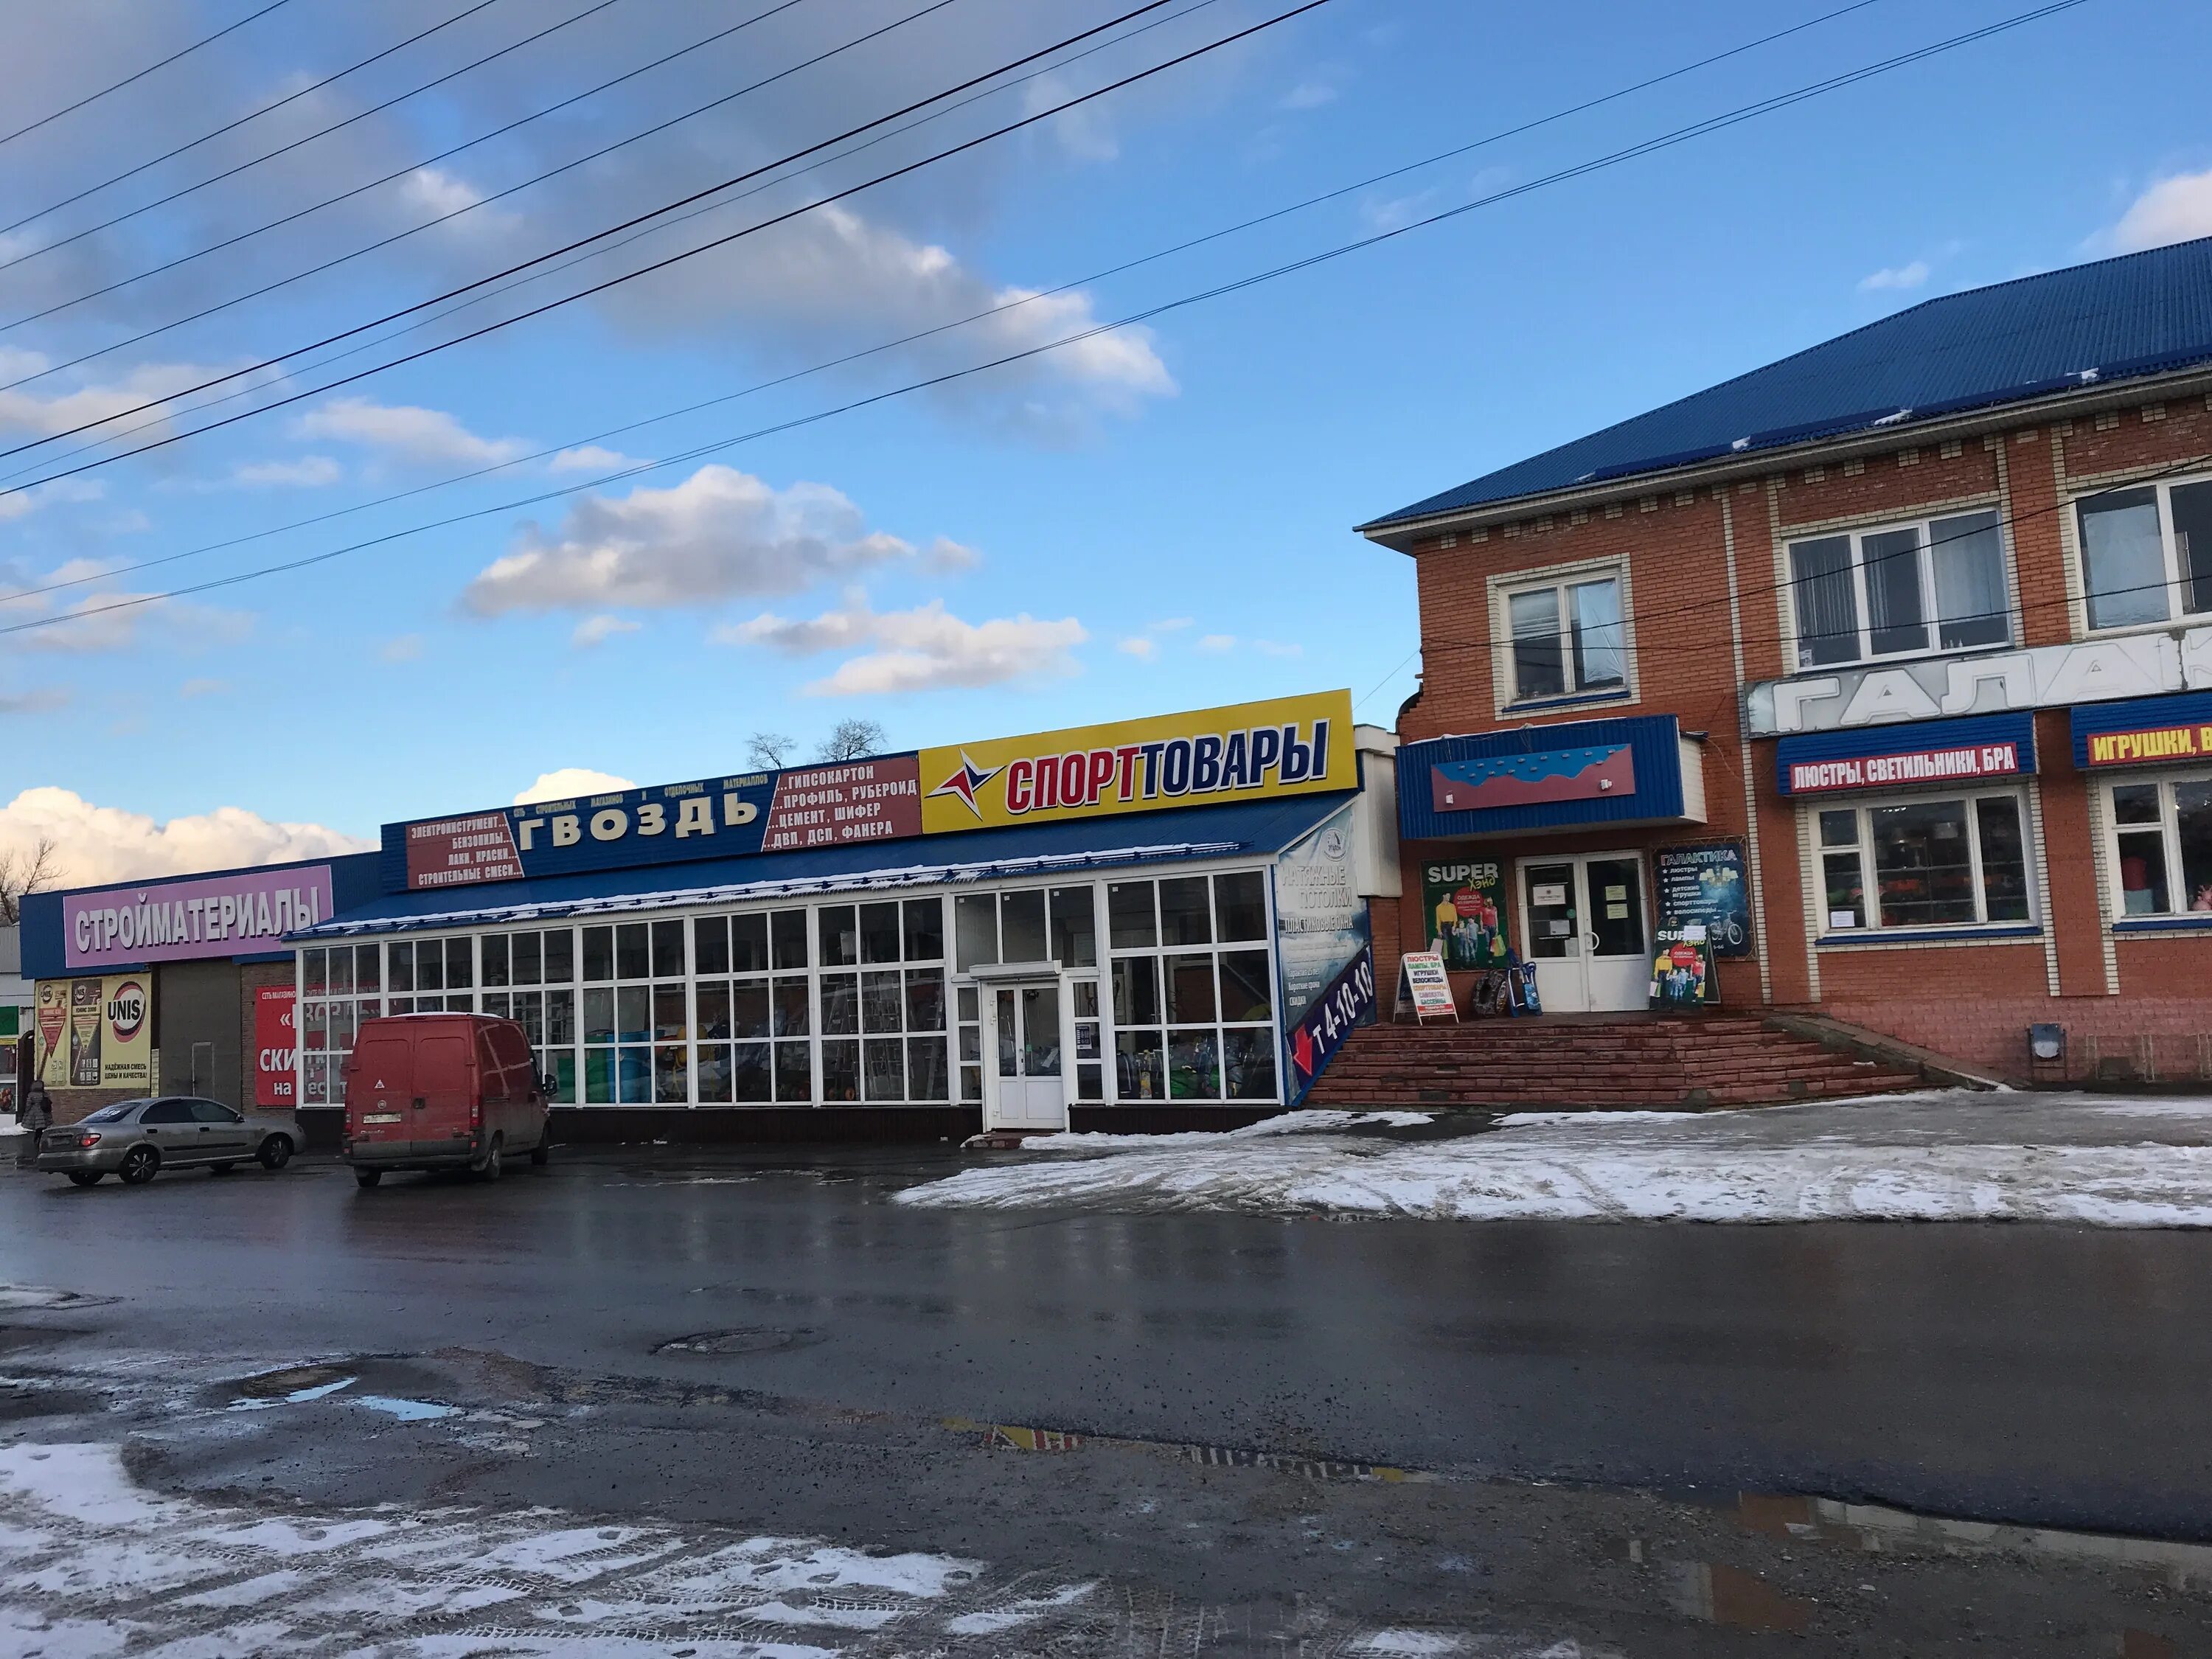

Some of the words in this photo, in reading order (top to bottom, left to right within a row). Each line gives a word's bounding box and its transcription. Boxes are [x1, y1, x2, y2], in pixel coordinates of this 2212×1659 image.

[2093, 728, 2197, 761] ИГРУШКИ,
[1005, 718, 1331, 815] СПОРТТОВАРЫ
[1795, 761, 1865, 789] ЛЮСТРЫ,
[1867, 751, 1980, 783] СВЕТИЛЬНИКИ,
[1983, 745, 2016, 773] БРА
[664, 783, 704, 799] ОТДЕЛОЧНЫХ
[852, 779, 917, 800] РУБЕРОИД
[835, 802, 881, 821] ШИФЕР
[518, 793, 759, 851] ГВОЗДЬ
[807, 828, 838, 845] ДСП,
[842, 821, 893, 838] ФАНЕРА
[1660, 849, 1737, 866] ГАЛАКТИКА
[419, 868, 481, 885] СТРОИТЕЛЬНЫЕ
[1282, 866, 1346, 886] НАТЯЖНЫЕ
[1428, 863, 1498, 883] SUPER
[1300, 887, 1352, 908] ПОТОЛКИ
[74, 887, 319, 952] СТРОЙМАТЕРИАЛЫ
[1284, 917, 1335, 933] ПЛАСТИКОВЫЕ
[1337, 914, 1354, 931] ОКНА
[272, 990, 296, 999] МАГАЗИНО
[1325, 961, 1373, 1040] 4-10-10
[108, 999, 140, 1020] UNIS
[105, 1062, 130, 1071] НАДЁЖНАЯ
[274, 1082, 291, 1095] на
